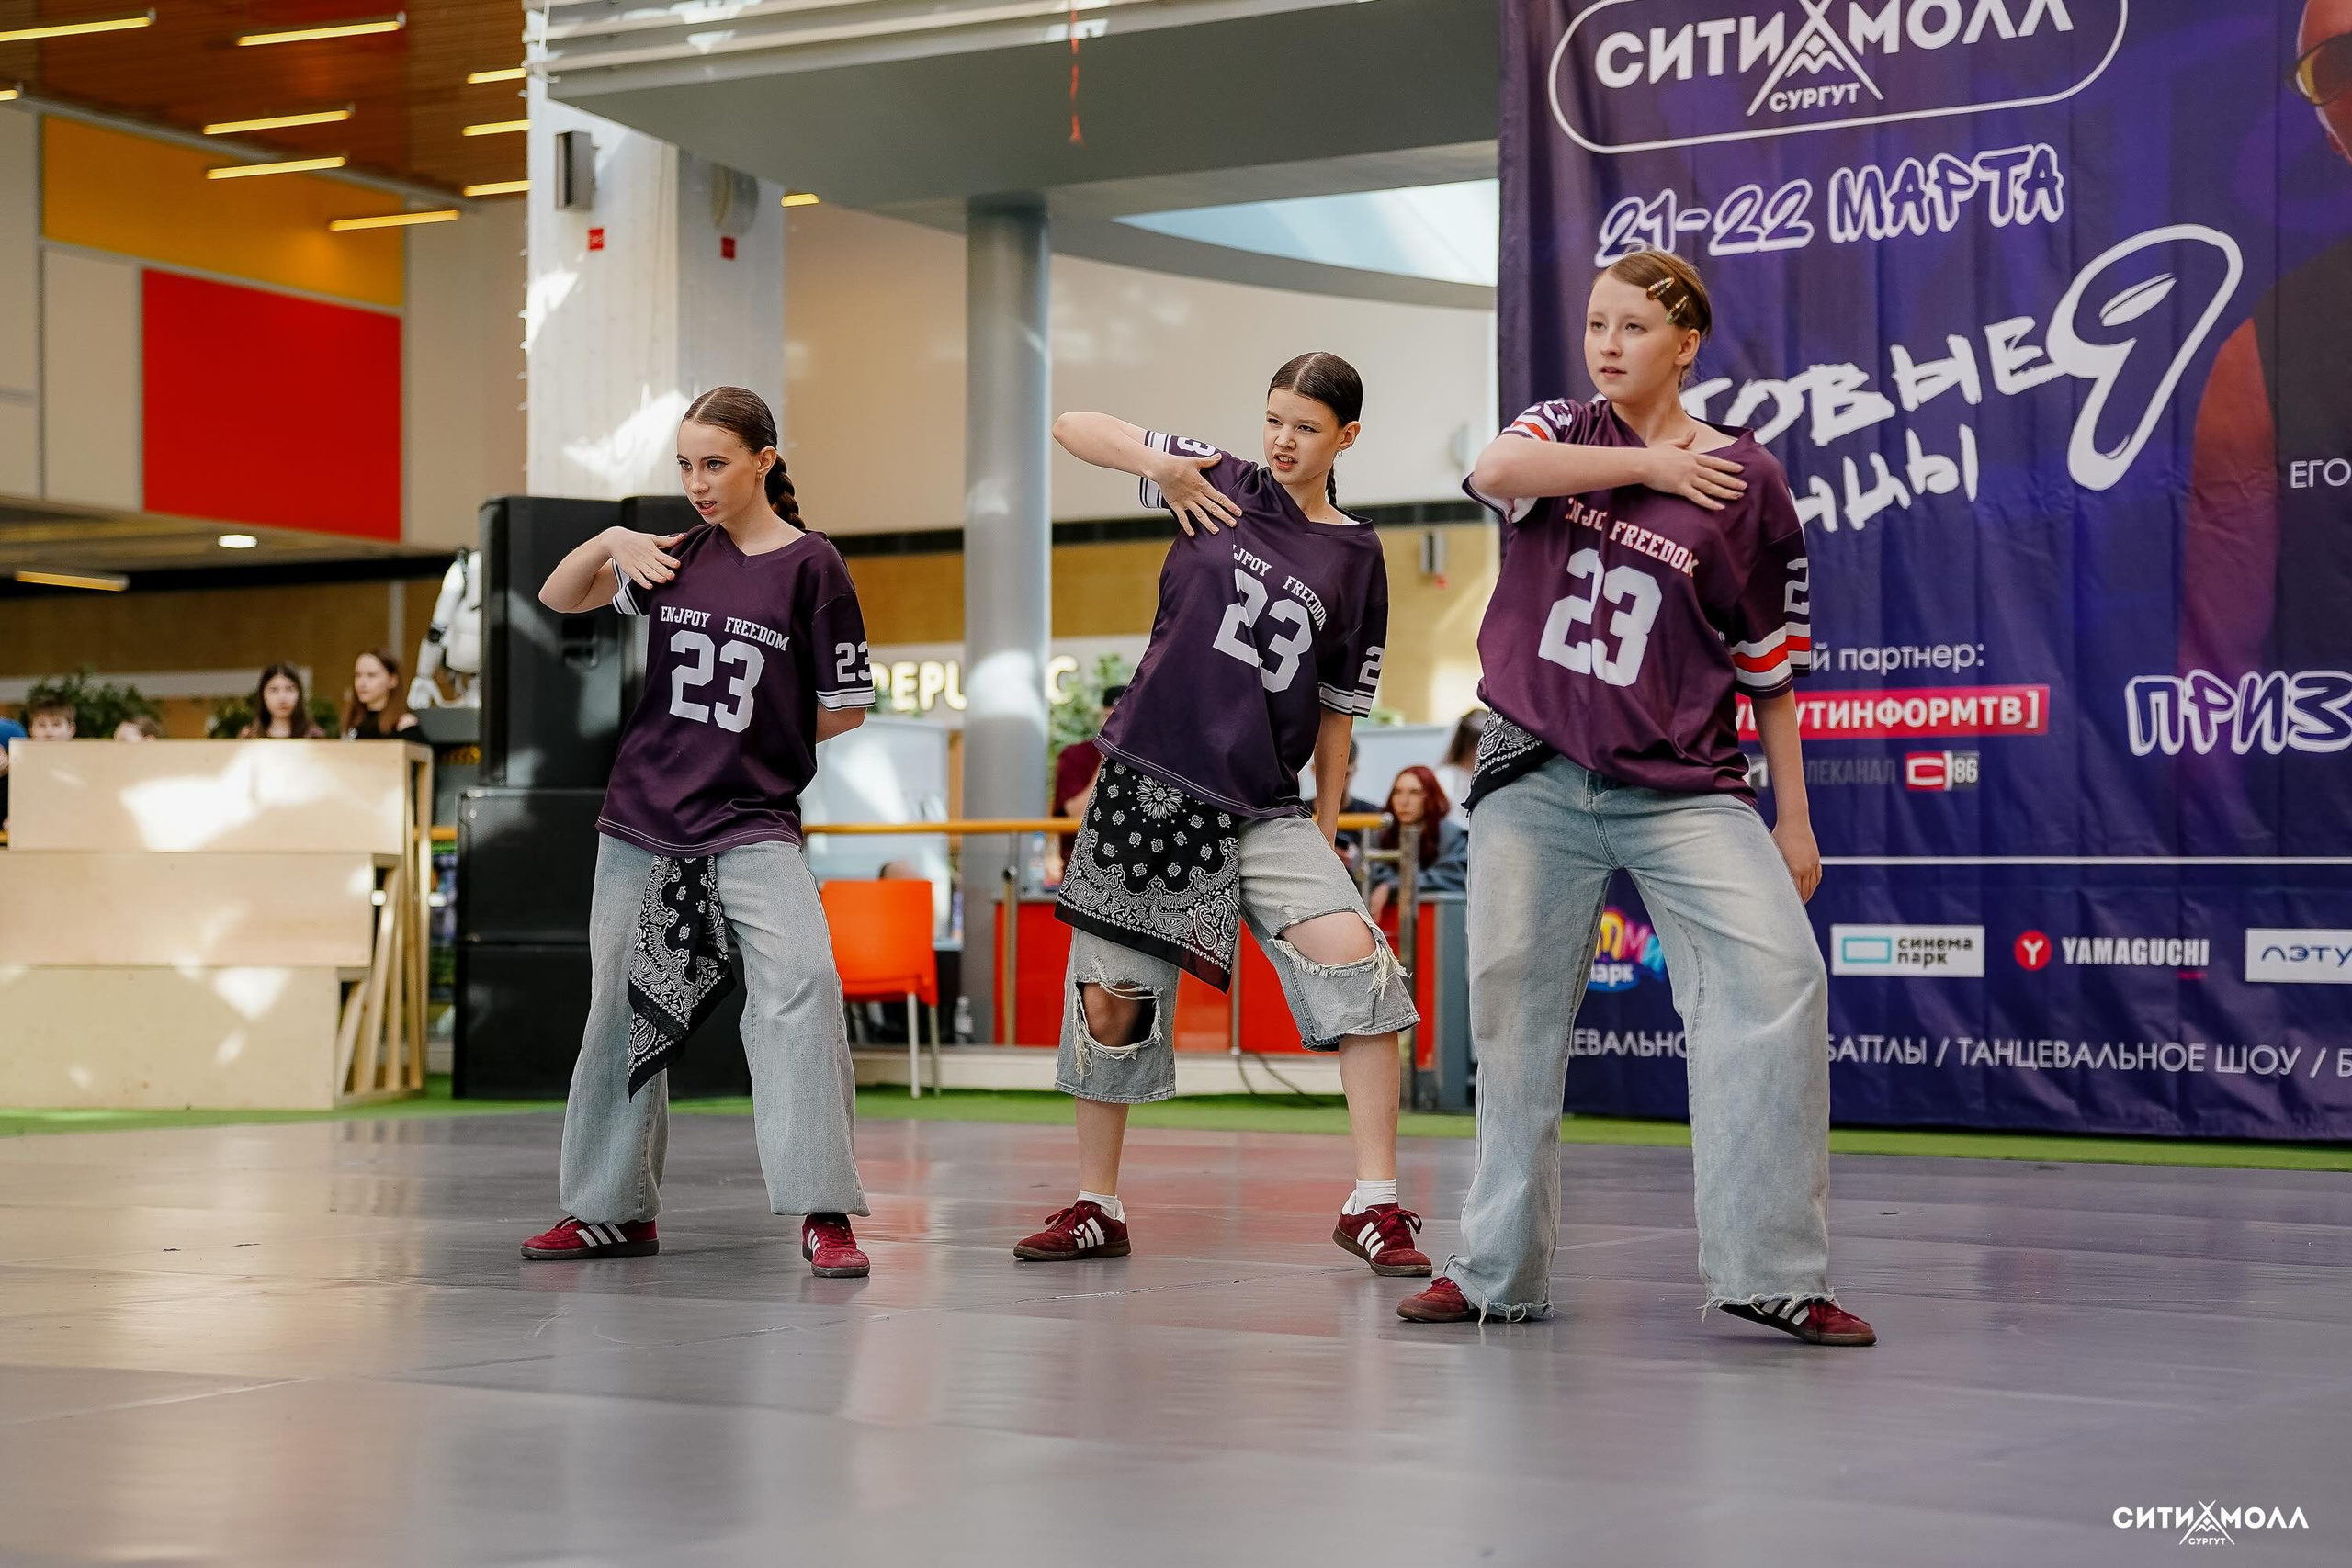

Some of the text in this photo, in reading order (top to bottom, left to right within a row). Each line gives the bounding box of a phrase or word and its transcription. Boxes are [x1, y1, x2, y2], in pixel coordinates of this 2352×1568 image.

[1769, 81, 1861, 114] СУРГУТ
[1594, 142, 2064, 269] 21-22 МАРТА
[661, 605, 790, 651] ENJPOY FREEDOM
[1212, 568, 1313, 694] 23
[1537, 547, 1663, 687] 23
[834, 641, 872, 683] 23
[1839, 643, 1985, 676] партнер:
[669, 629, 765, 734] 23
[1897, 936, 1973, 952] синема
[1897, 952, 1949, 970] парк
[2061, 937, 2211, 967] YAMAGUCHI
[1956, 1037, 2207, 1073] ТАНЦЕВАЛЬНОЕ
[2214, 1044, 2301, 1077] ШОУ
